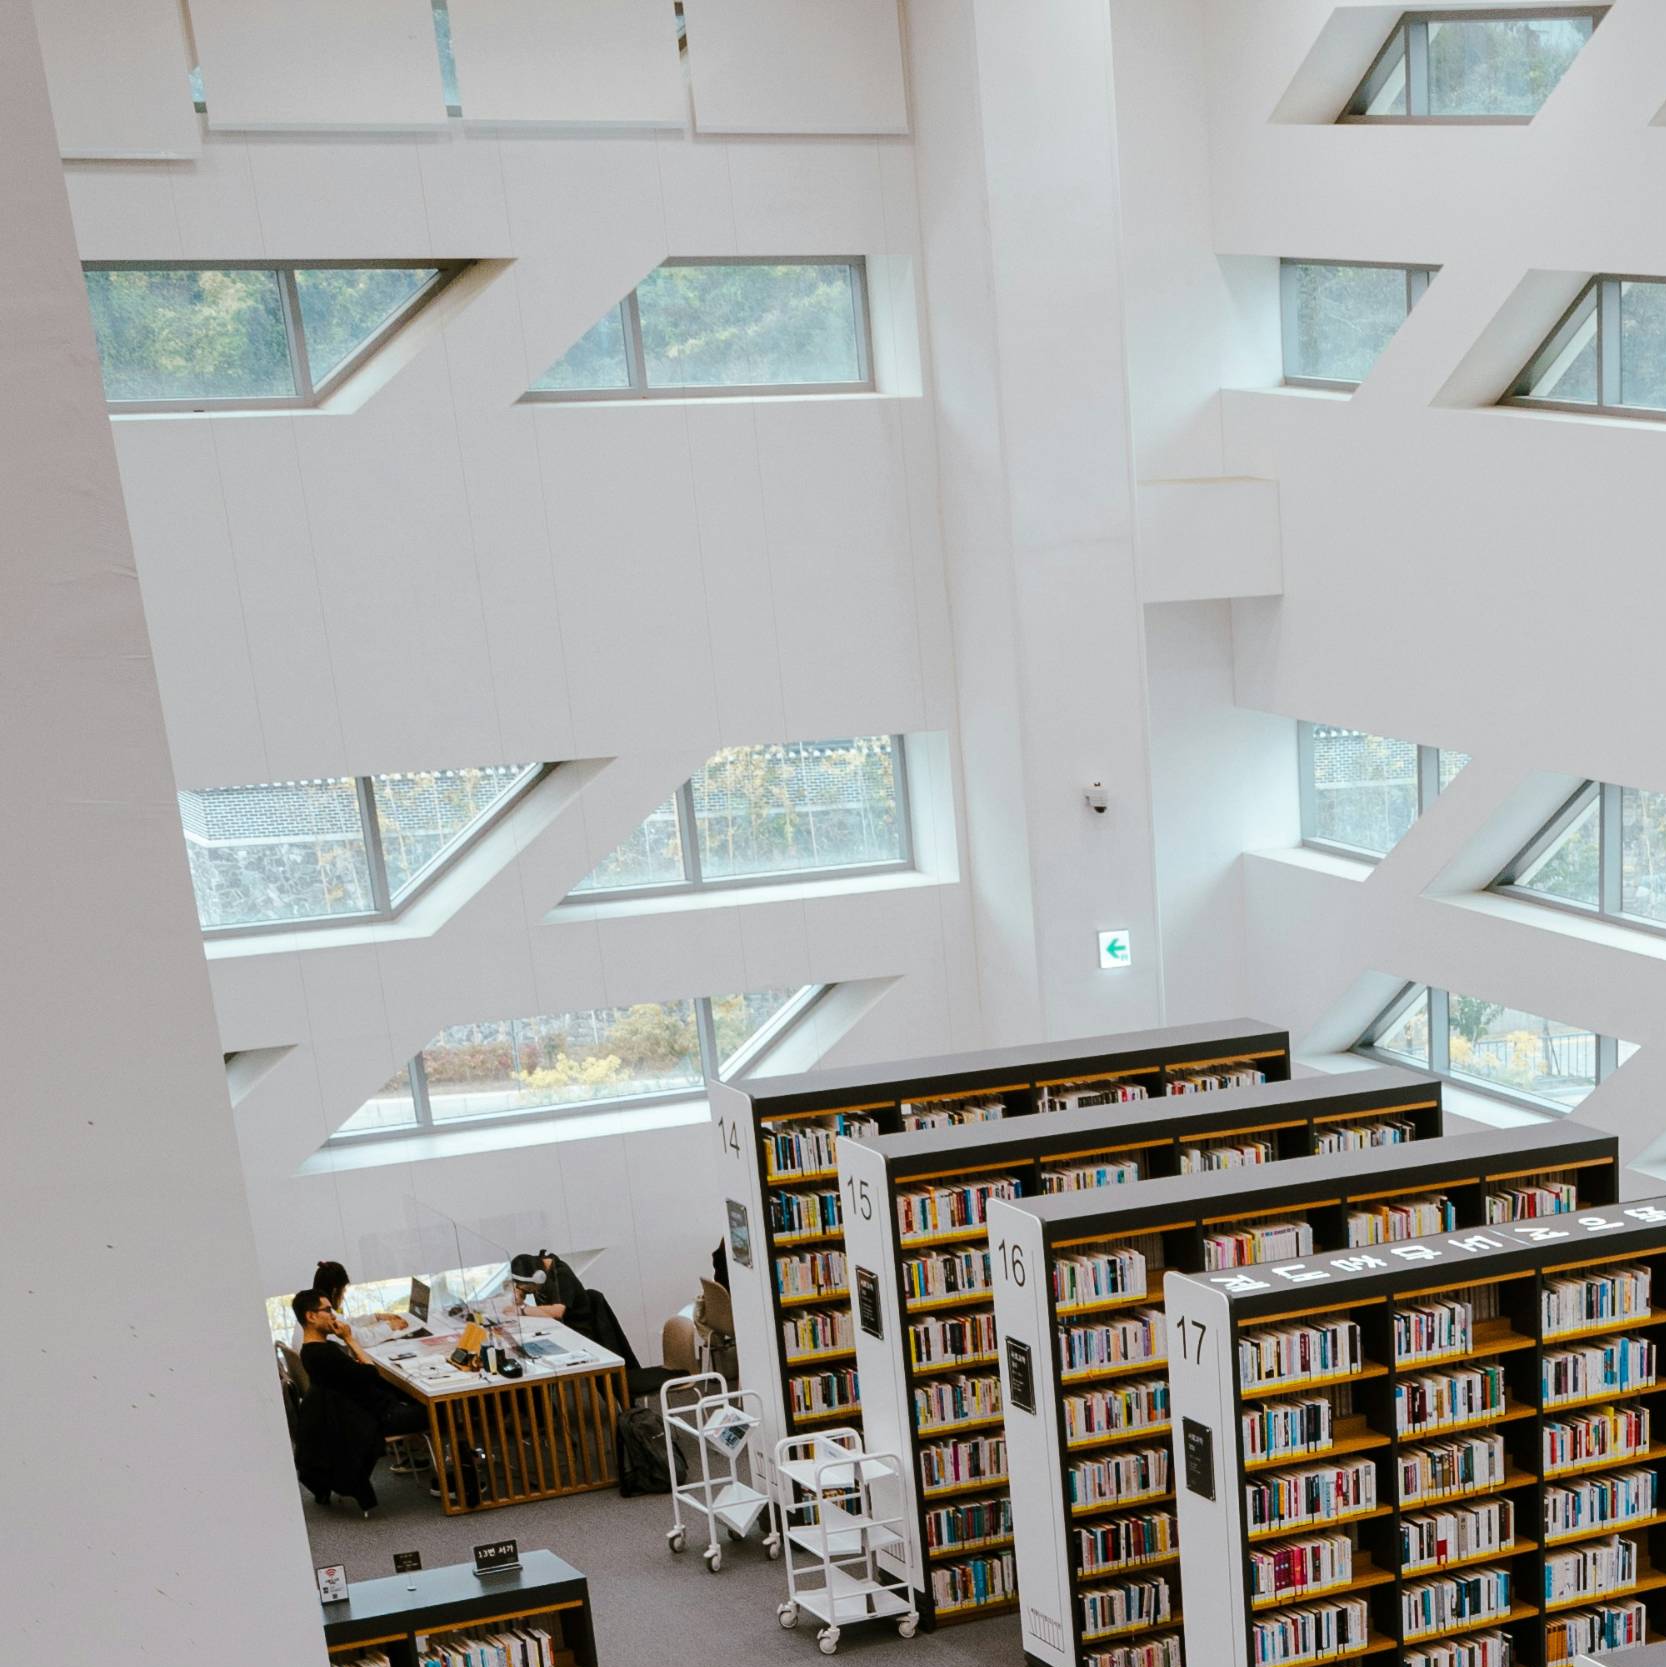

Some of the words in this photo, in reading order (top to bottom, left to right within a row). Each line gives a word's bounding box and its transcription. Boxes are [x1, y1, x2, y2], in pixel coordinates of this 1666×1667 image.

[718, 1115, 741, 1160] 14
[847, 1174, 873, 1222] 15
[997, 1238, 1027, 1288] 16
[1176, 1314, 1207, 1366] 17
[477, 1548, 496, 1559] 13번
